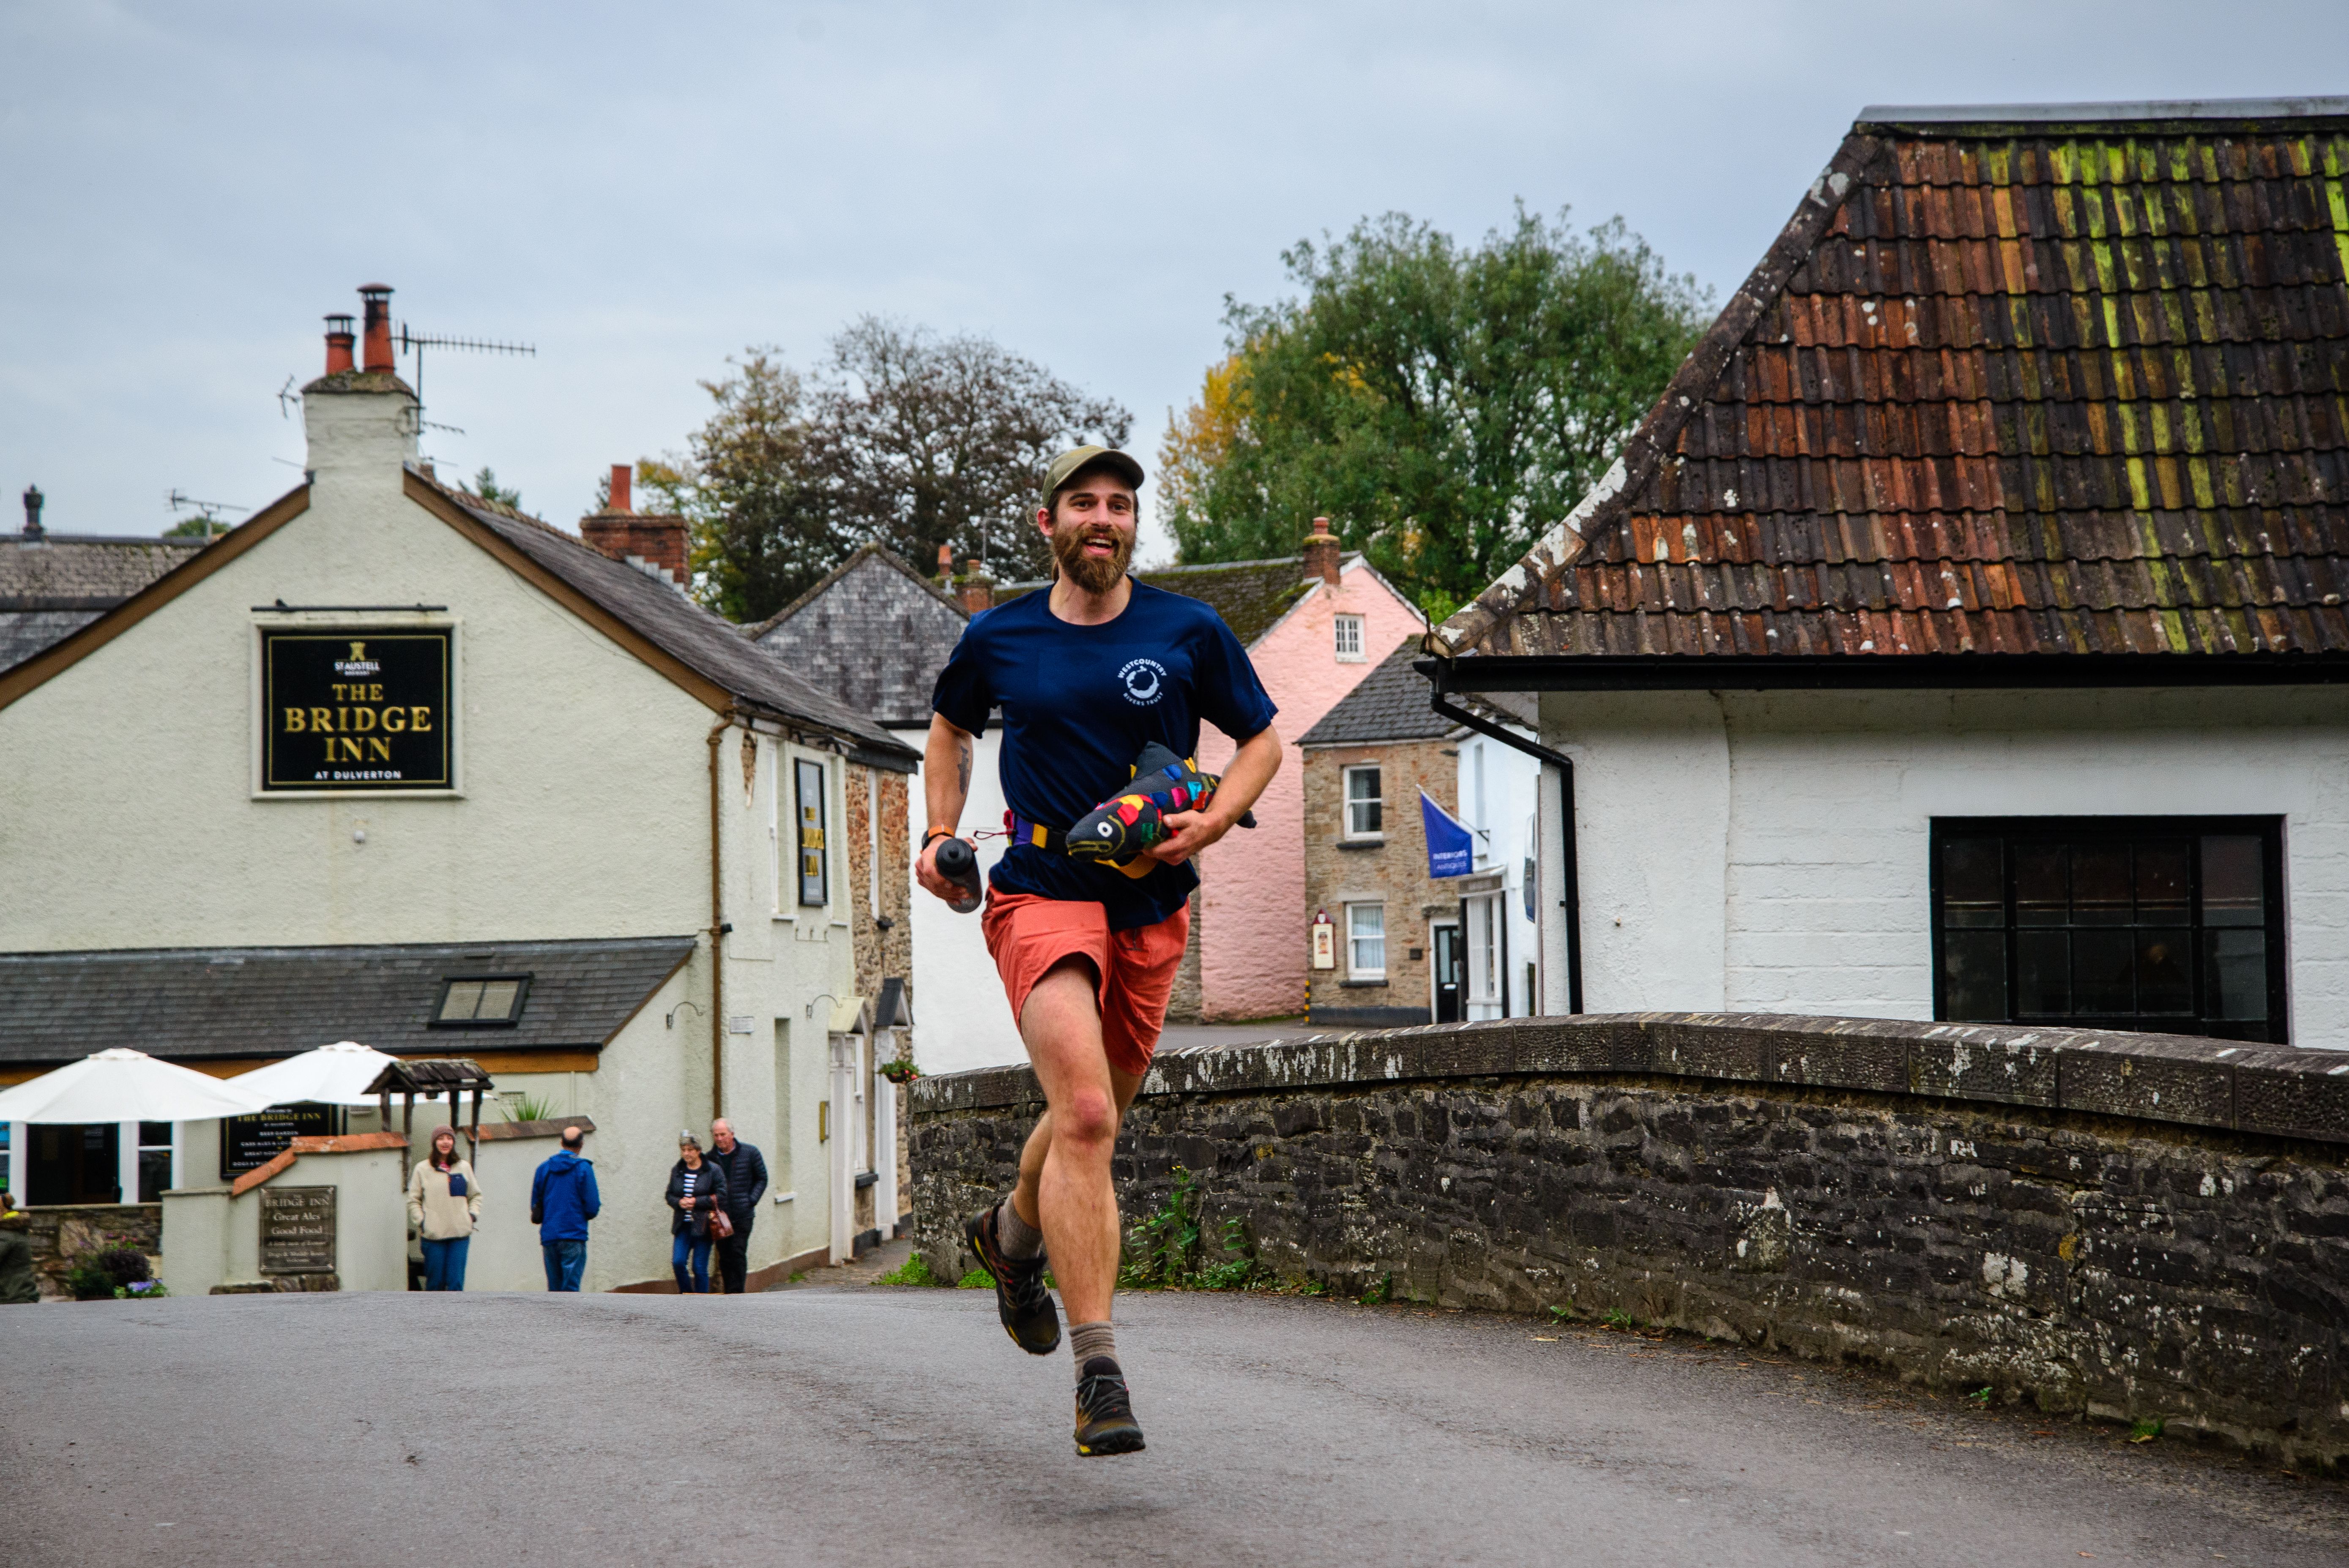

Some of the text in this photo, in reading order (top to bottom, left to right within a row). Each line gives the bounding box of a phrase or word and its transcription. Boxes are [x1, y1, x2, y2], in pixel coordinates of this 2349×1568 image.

[1117, 658, 1167, 678] WESTCOUNTRY
[331, 684, 383, 702] THE
[1123, 692, 1163, 706] RIVERS TRUST
[284, 706, 432, 732] BRIDGE
[324, 737, 391, 762] INN
[314, 770, 402, 780] AT DULVERTON
[1433, 850, 1467, 860] INTERIORS
[261, 1113, 299, 1121] BRIDGE
[273, 1213, 299, 1221] Great
[299, 1226, 323, 1234] Food
